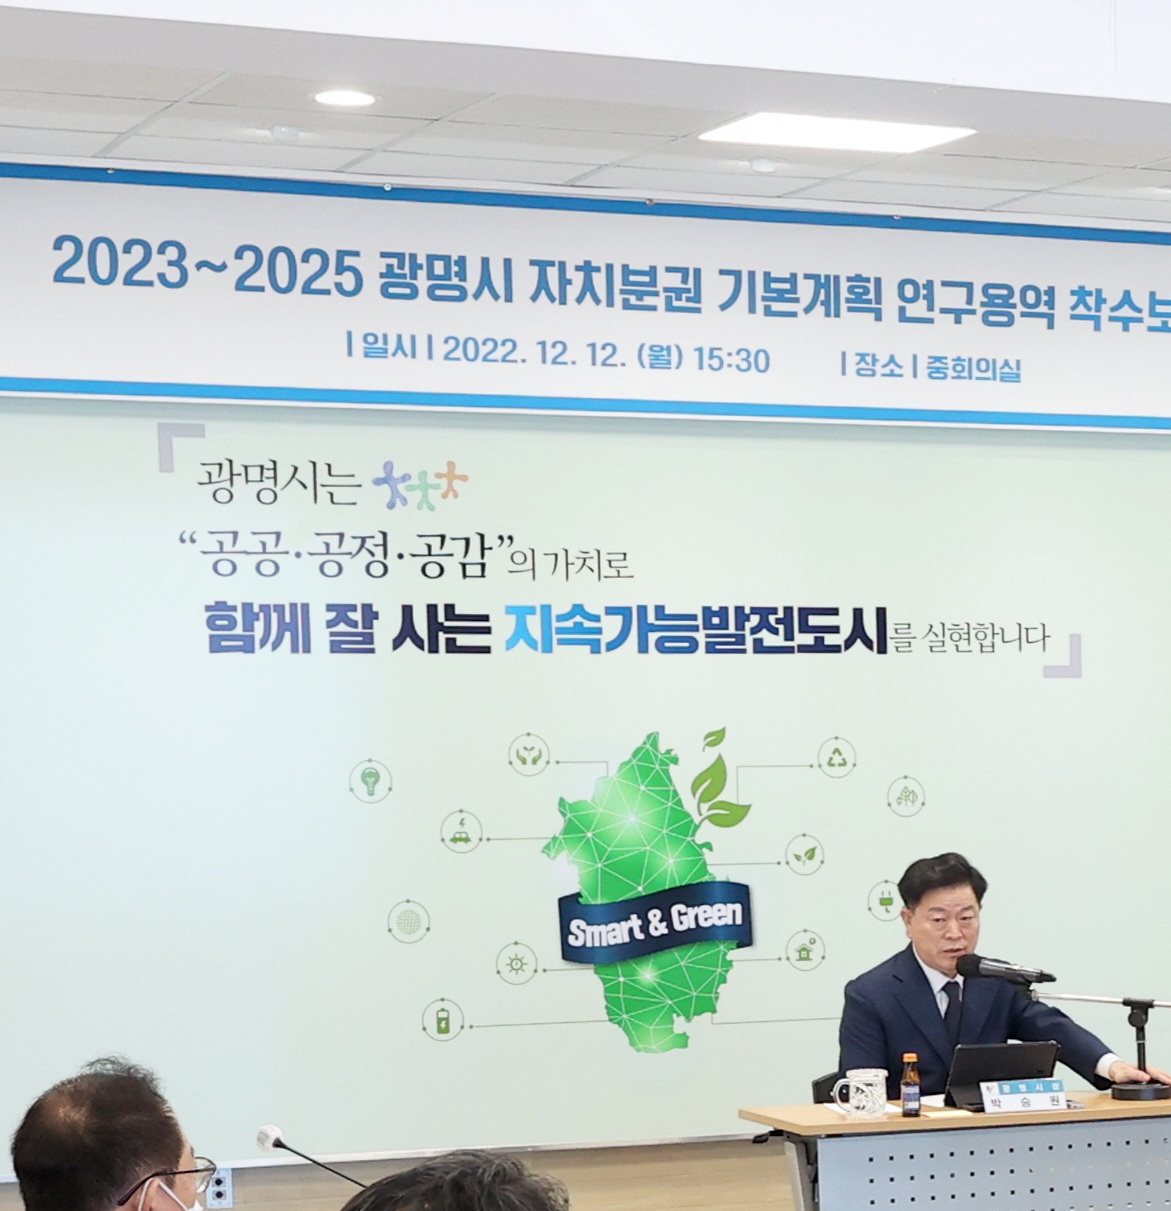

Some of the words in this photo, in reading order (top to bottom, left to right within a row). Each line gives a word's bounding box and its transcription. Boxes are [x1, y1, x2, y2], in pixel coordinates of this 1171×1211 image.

[52, 234, 364, 298] 2023~2025
[378, 250, 515, 304] 광명시
[529, 258, 703, 314] 자치분권
[717, 267, 884, 322] 기본계획
[897, 276, 1057, 330] 연구용역
[443, 335, 528, 365] 2022.
[536, 339, 578, 367] 12.
[585, 341, 628, 368] 12.
[636, 343, 684, 371] (월)
[693, 346, 771, 374] 15:30
[925, 354, 1023, 385] 중회의실
[197, 457, 363, 506] 광명시는
[544, 547, 636, 583] 가치로
[204, 600, 312, 655] 함께
[325, 602, 380, 655] 잘
[391, 602, 493, 655] 사는
[920, 620, 1052, 655] 실현합니다
[566, 912, 646, 948] Smart
[647, 906, 669, 937] &
[670, 900, 744, 932] Green
